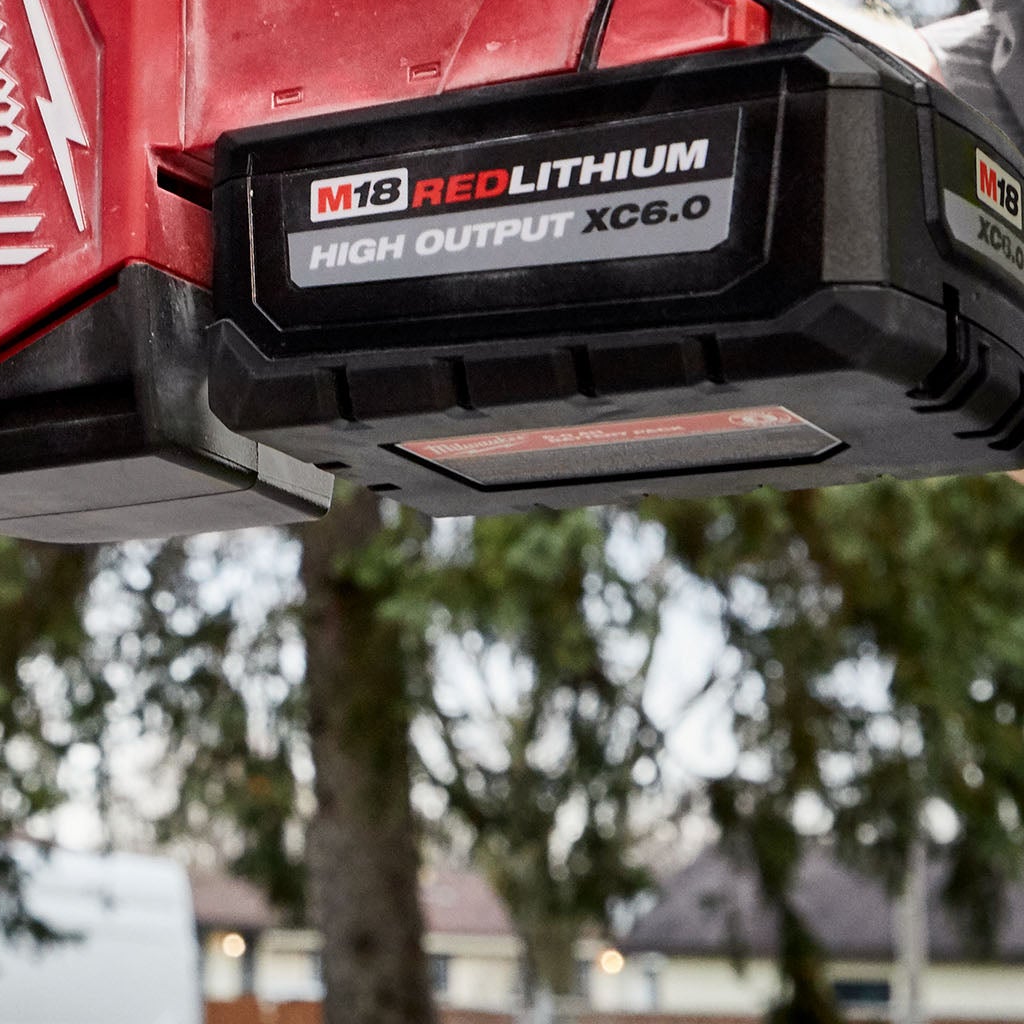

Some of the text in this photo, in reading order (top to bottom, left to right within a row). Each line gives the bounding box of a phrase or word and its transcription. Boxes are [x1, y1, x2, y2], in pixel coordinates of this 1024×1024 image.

[317, 139, 709, 214] M18 REDLITHIUM
[979, 159, 1019, 217] M18
[309, 194, 711, 270] HIGH OUTPUT XC6.0
